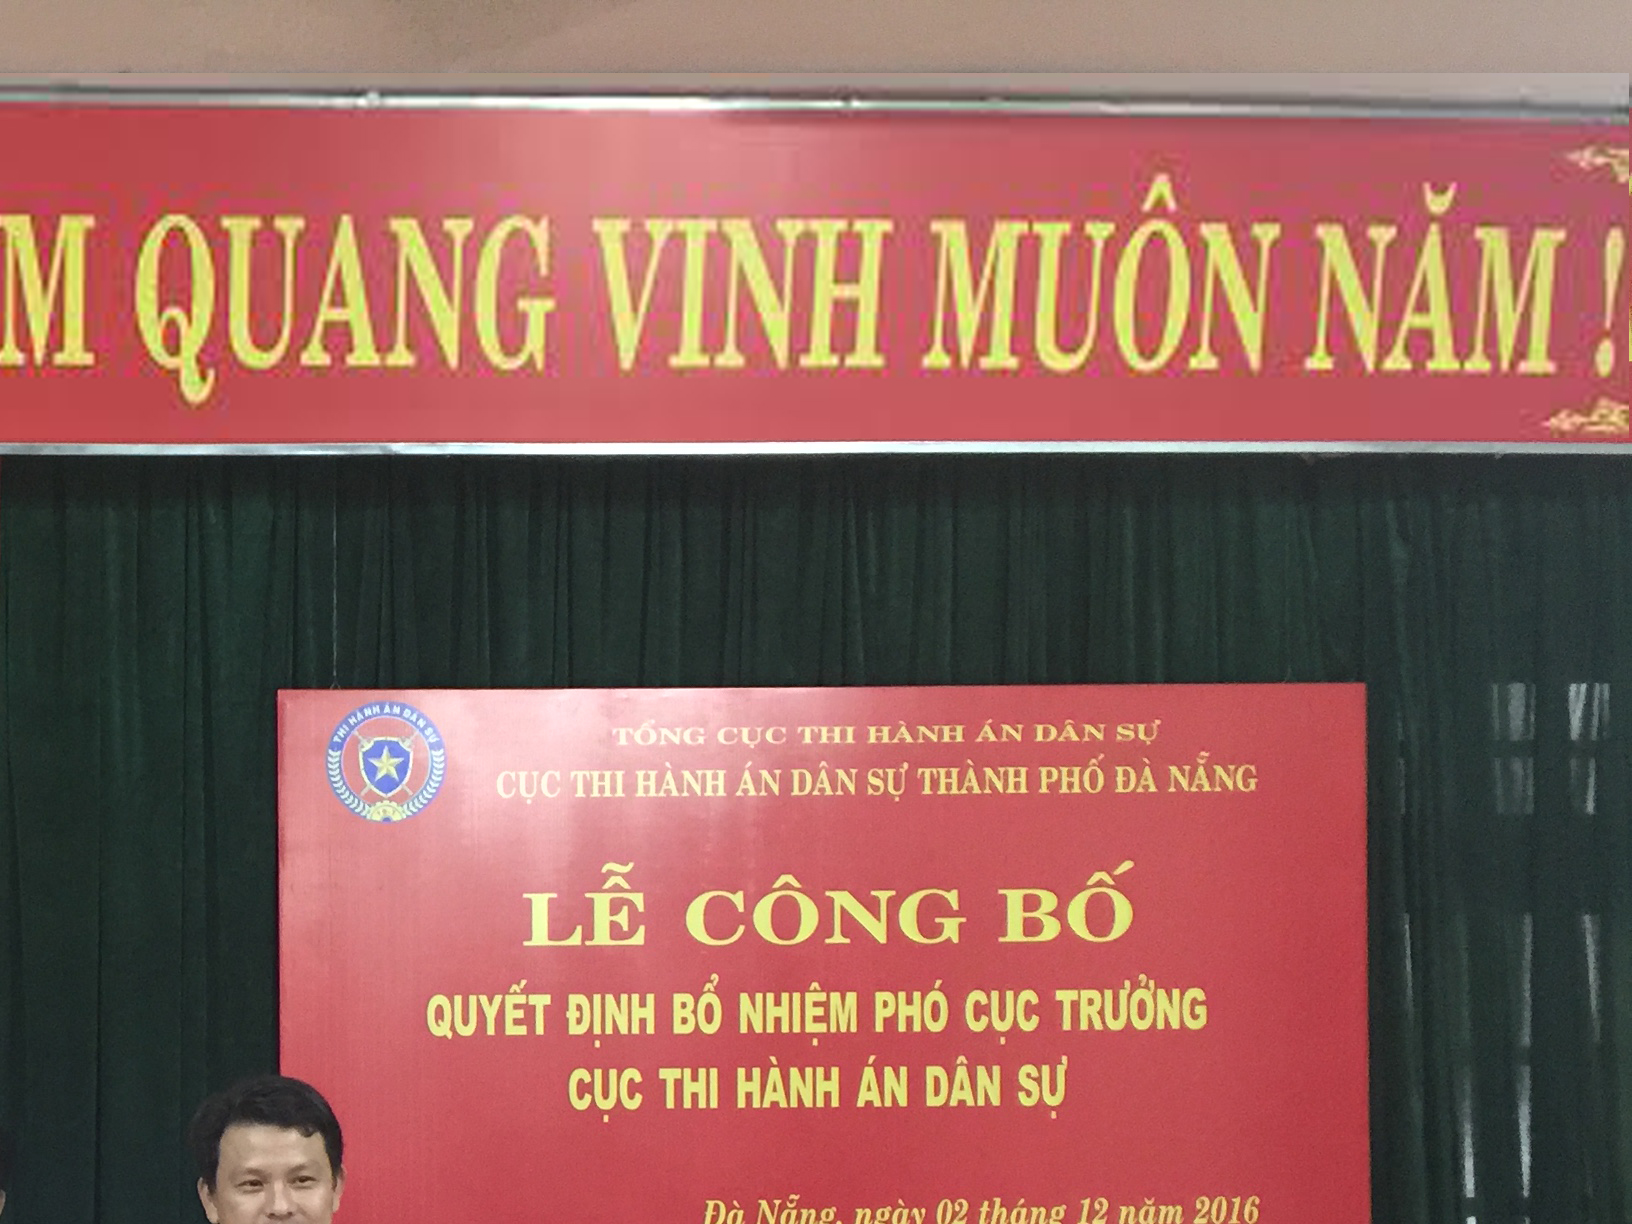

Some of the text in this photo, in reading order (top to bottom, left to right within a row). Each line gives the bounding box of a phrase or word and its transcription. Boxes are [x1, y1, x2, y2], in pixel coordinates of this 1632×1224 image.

[135, 213, 557, 403] QUANG
[593, 216, 894, 369] VINH
[923, 174, 1282, 371] MUÔN
[1305, 182, 1567, 374] NĂM
[1595, 227, 1626, 377] !
[332, 724, 350, 743] THI
[348, 704, 381, 726] HÀNH
[383, 702, 401, 714] ÁN
[613, 719, 1161, 749] TỔNG CỤC THI HÀNH ÁN DÂN SỰ
[496, 752, 1258, 804] CỤC THI HÀNH ÁN DÂN SỰ THÀNH PHỐ ĐÀ NẴNG
[523, 859, 1135, 946] LỄ CÔNG BỐ
[427, 973, 1207, 1047] QUYẾT ĐỊNH BỔ NHIỆM PHÓ CỤC TRƯỞNG
[568, 1055, 1068, 1122] CỤC THI HÀNH ÁN DÂN SỰ
